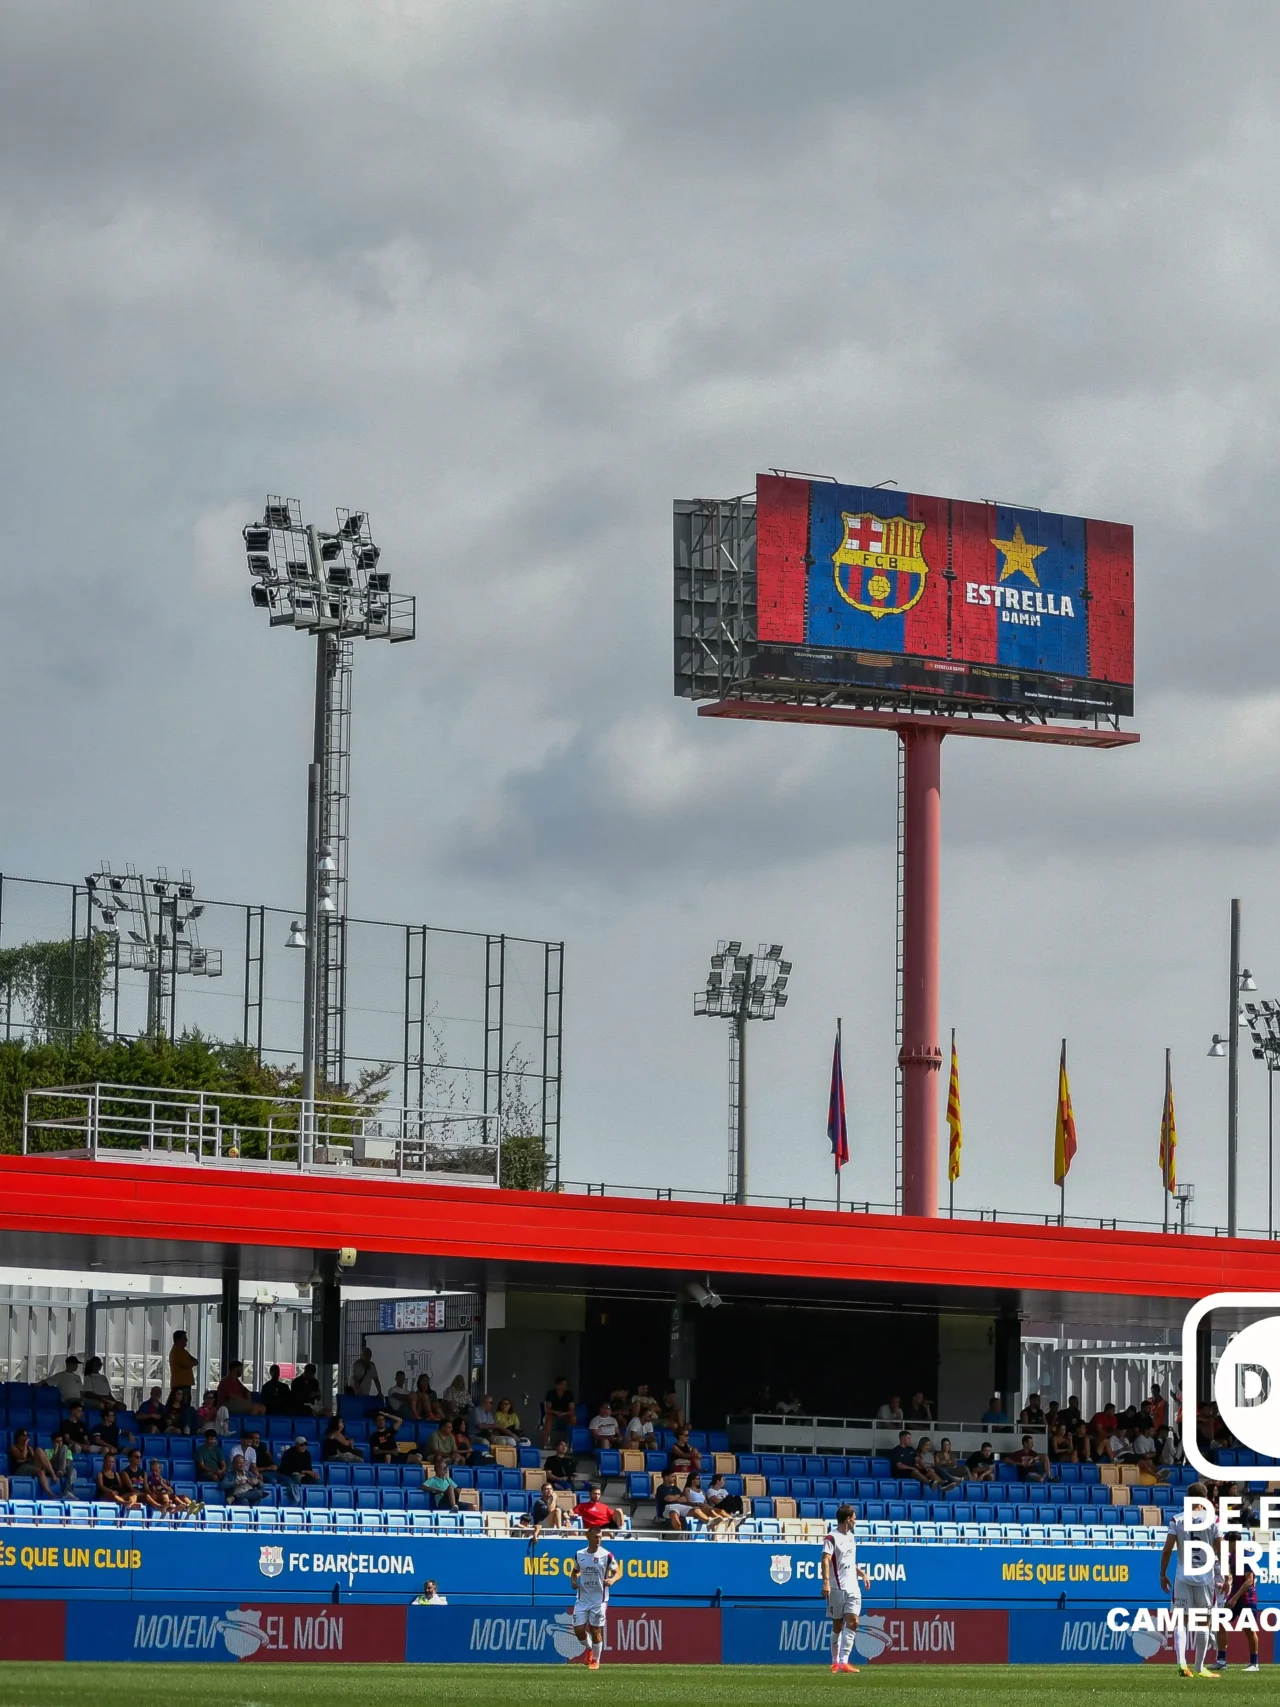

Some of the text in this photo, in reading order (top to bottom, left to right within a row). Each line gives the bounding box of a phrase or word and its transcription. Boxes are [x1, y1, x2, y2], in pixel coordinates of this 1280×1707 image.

[862, 553, 898, 570] FCB
[966, 582, 1075, 618] ESTRELLA
[1002, 610, 1041, 627] DAMM
[21, 1547, 58, 1571] QUE
[63, 1548, 89, 1567] UN
[94, 1549, 141, 1569] CLUB
[289, 1553, 414, 1574] FC BARCELONA
[524, 1553, 559, 1575] MÉS
[628, 1559, 669, 1578] CLUB
[796, 1561, 814, 1580] FC
[1002, 1559, 1129, 1584] MÉS QUE UN CLUB
[134, 1610, 343, 1650] MOVEM EL MÓN
[470, 1618, 549, 1650] MOVEM
[617, 1613, 662, 1651] MÓN
[779, 1615, 955, 1651] MOVE EL MÓN
